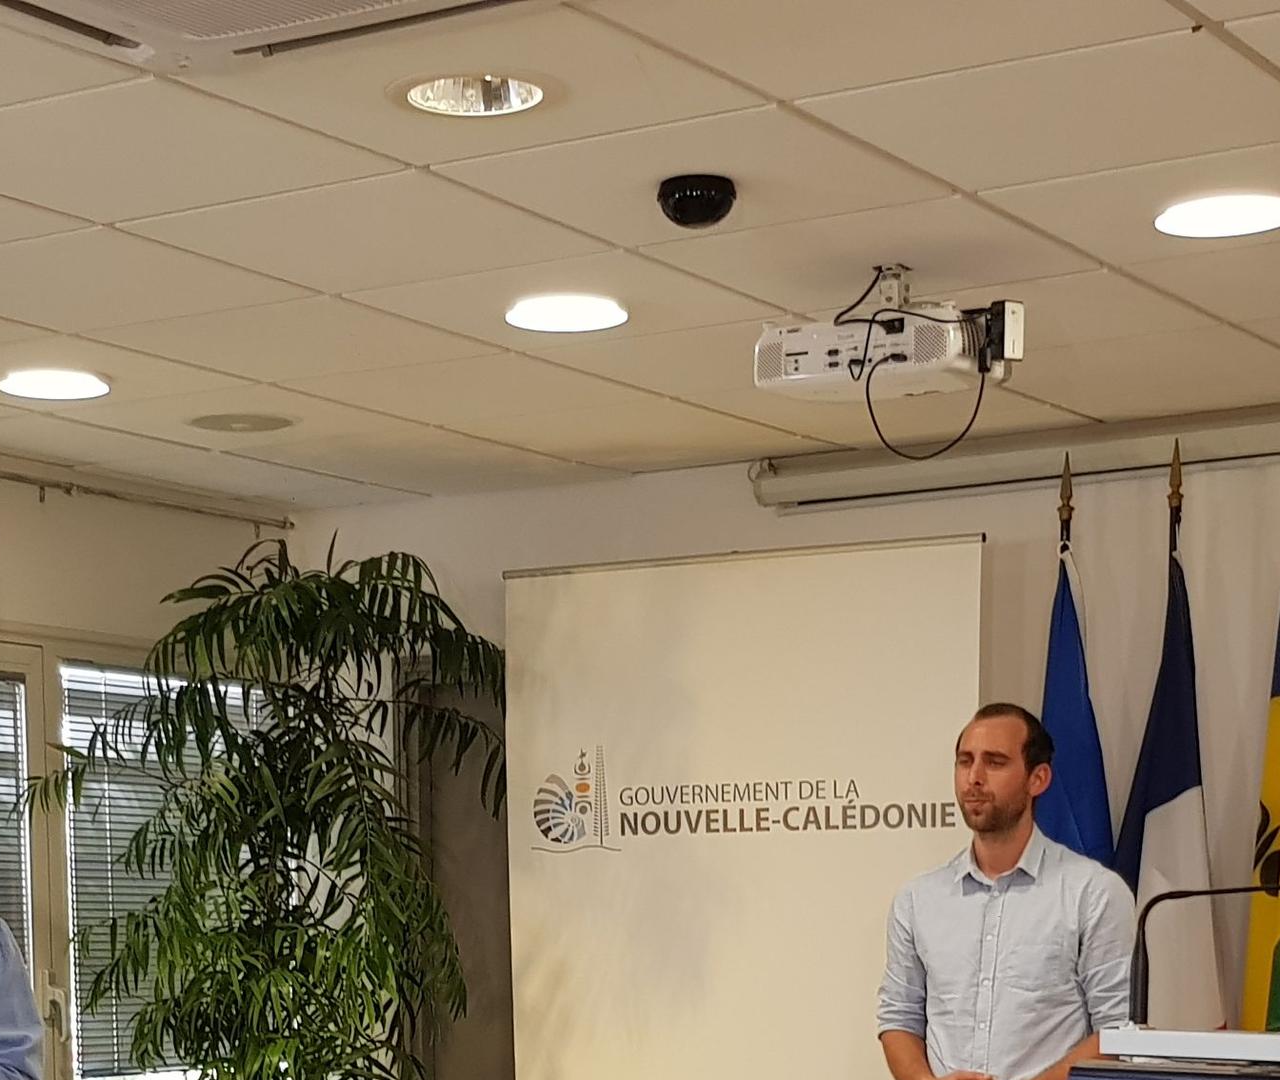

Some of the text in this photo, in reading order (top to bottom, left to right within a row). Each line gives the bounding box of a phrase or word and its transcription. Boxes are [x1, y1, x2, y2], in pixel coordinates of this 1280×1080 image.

[620, 779, 860, 806] GOUVERNEMENT DE LA
[620, 800, 956, 836] NOUVELLE-CALÉDONIE
